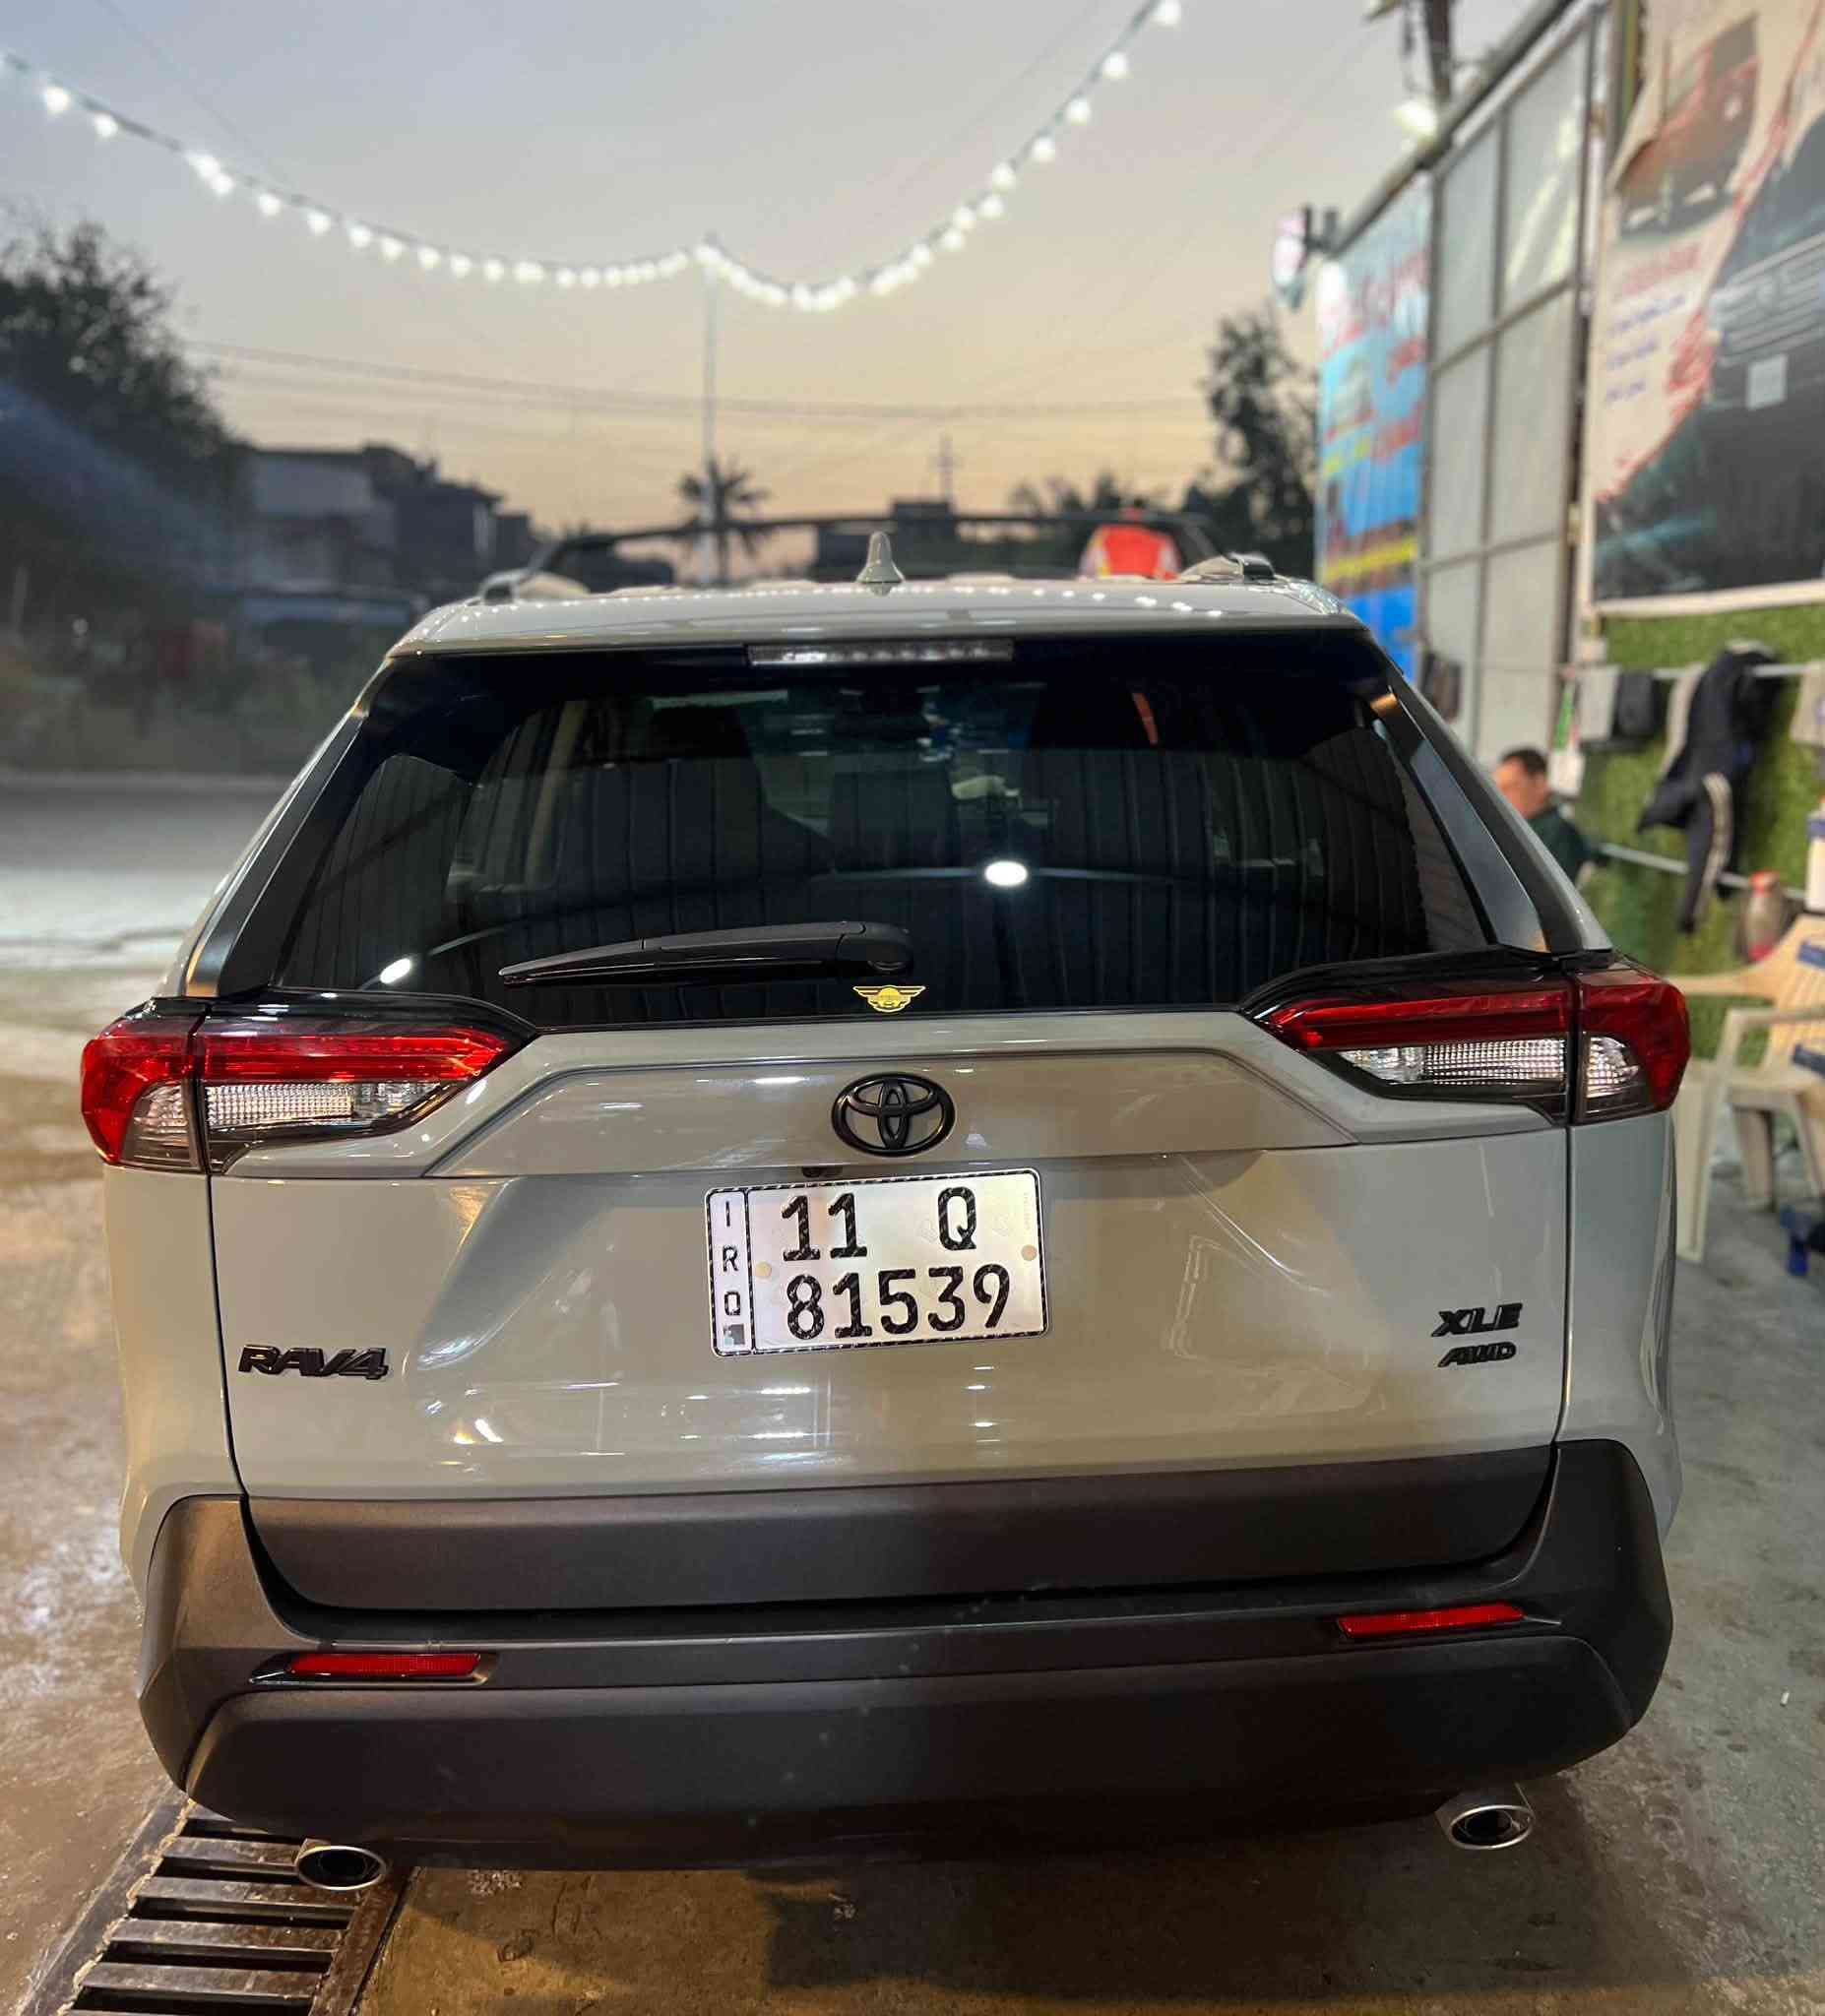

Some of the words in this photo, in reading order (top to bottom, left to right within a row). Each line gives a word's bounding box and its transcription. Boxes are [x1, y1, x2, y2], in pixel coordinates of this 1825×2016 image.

[781, 1192, 868, 1262] 11
[937, 1186, 977, 1251] Q
[723, 1200, 741, 1317] IRQ
[787, 1264, 1011, 1340] 81539
[1430, 1302, 1524, 1338] XLE
[237, 1344, 389, 1380] RAV4
[1436, 1341, 1517, 1368] AWD
